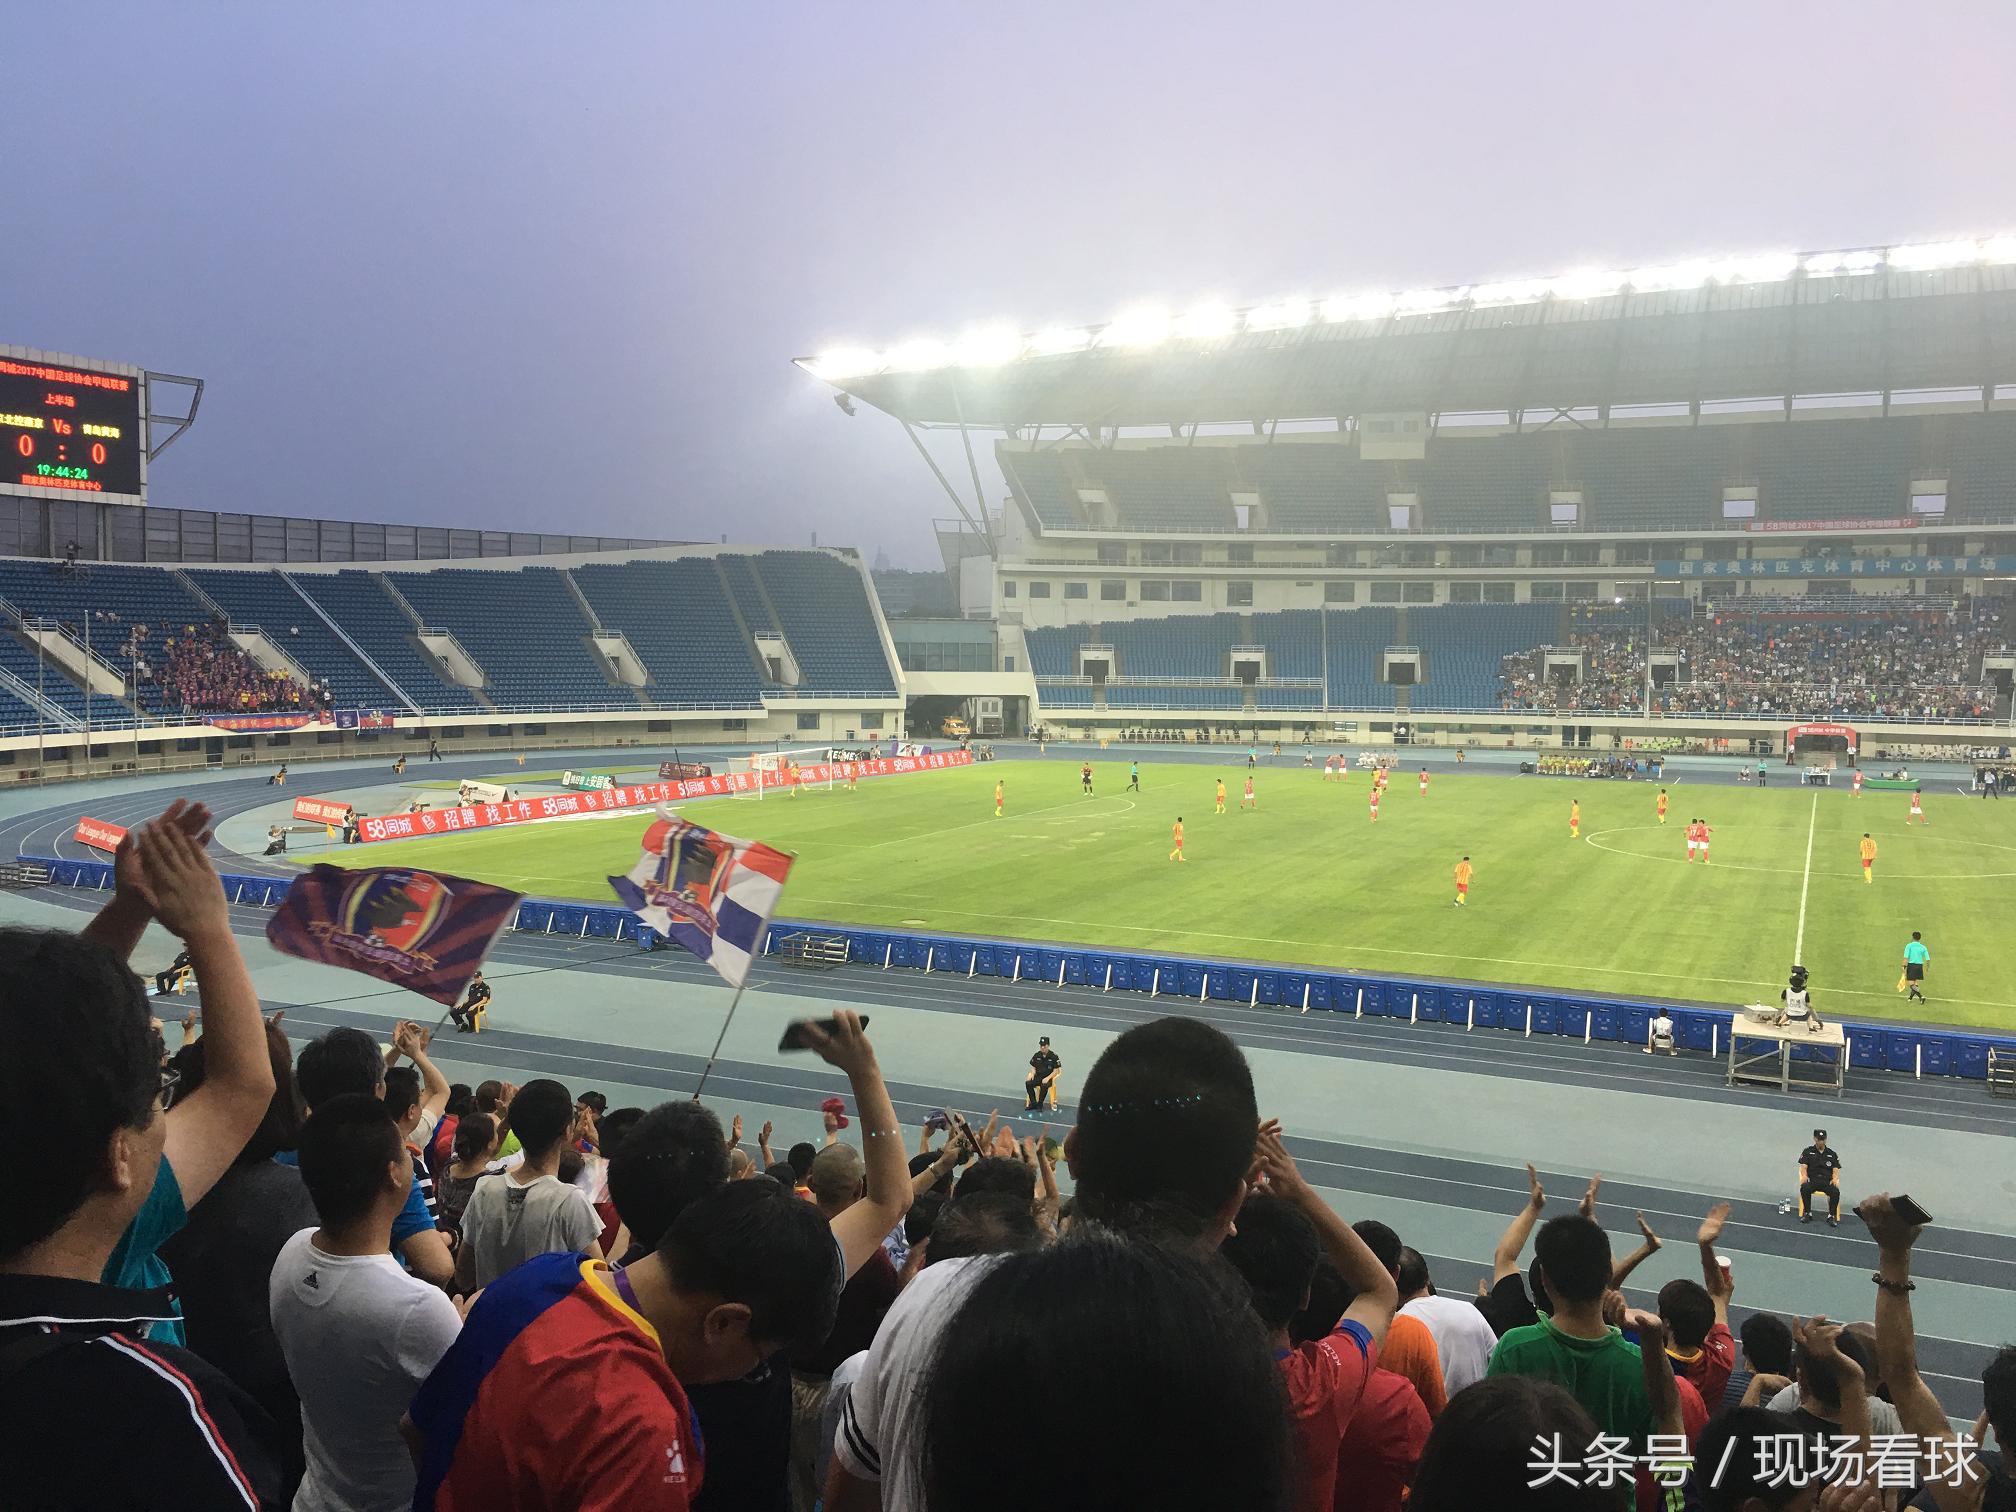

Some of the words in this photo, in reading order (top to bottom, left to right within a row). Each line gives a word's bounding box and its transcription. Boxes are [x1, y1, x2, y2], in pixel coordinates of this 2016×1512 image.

[44, 393, 76, 408] 上半场
[53, 418, 72, 435] Vs
[18, 434, 33, 457] 0
[91, 442, 106, 464] 0
[37, 463, 89, 480] 19:44:24
[21, 474, 102, 491] 国家奥林匹克体育中心
[1679, 557, 1997, 575] 国家奥林匹克体育中心体育场
[367, 818, 414, 841] 58同城
[444, 808, 478, 830] 招聘
[487, 801, 533, 823] 找工作
[542, 795, 580, 816] 58同城
[601, 789, 629, 807] 招聘
[635, 784, 671, 803] 找工作
[725, 775, 748, 791] 招聘
[858, 761, 887, 776] 找工作
[893, 758, 916, 772] 58同城
[929, 753, 945, 767] 招聘
[948, 751, 968, 765] 找工作
[1320, 1341, 1342, 1366] KELME
